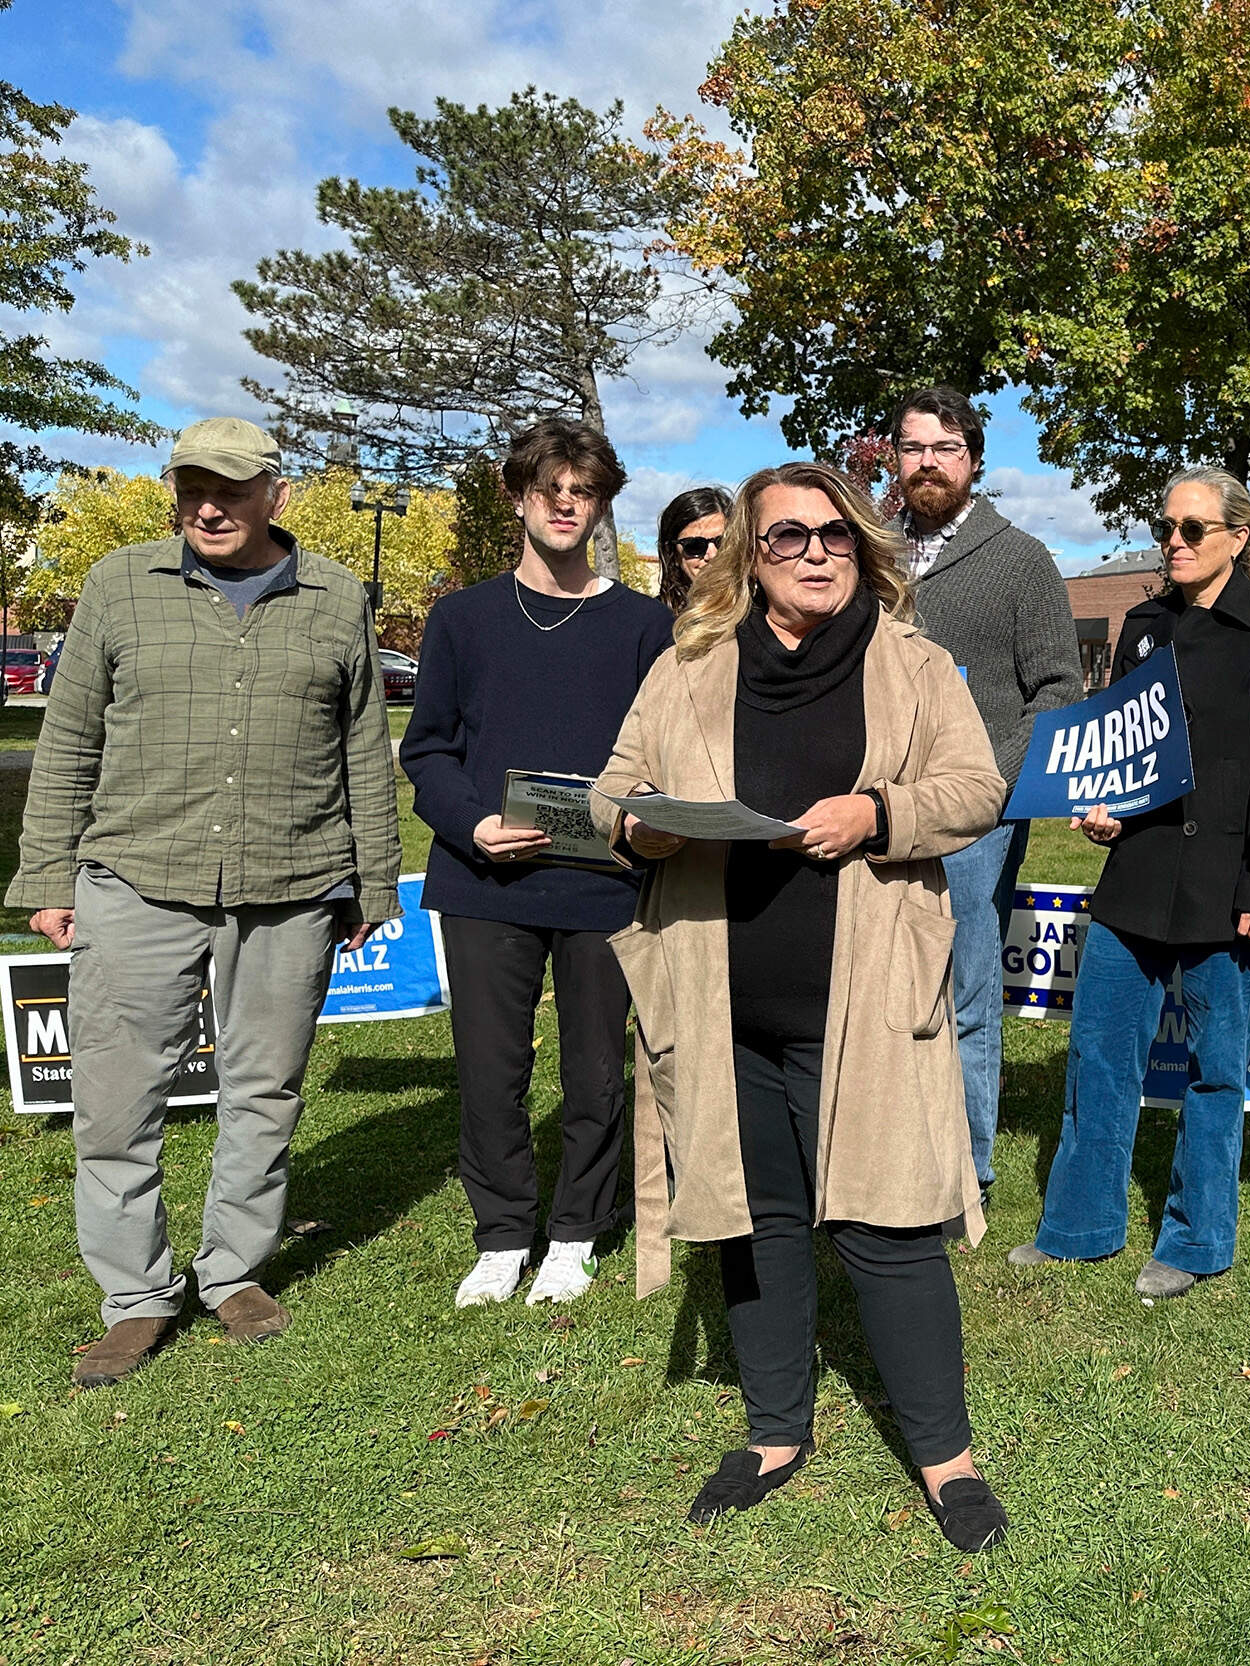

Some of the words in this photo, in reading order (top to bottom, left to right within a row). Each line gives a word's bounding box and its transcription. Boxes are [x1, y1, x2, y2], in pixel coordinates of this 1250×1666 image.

[1045, 681, 1170, 775] HARRIS
[1068, 751, 1159, 800] WALZ
[526, 791, 546, 799] WIN
[561, 795, 590, 805] NOVE
[530, 786, 557, 796] SCAN
[1028, 921, 1078, 946] JAR
[332, 944, 390, 974] ALZ
